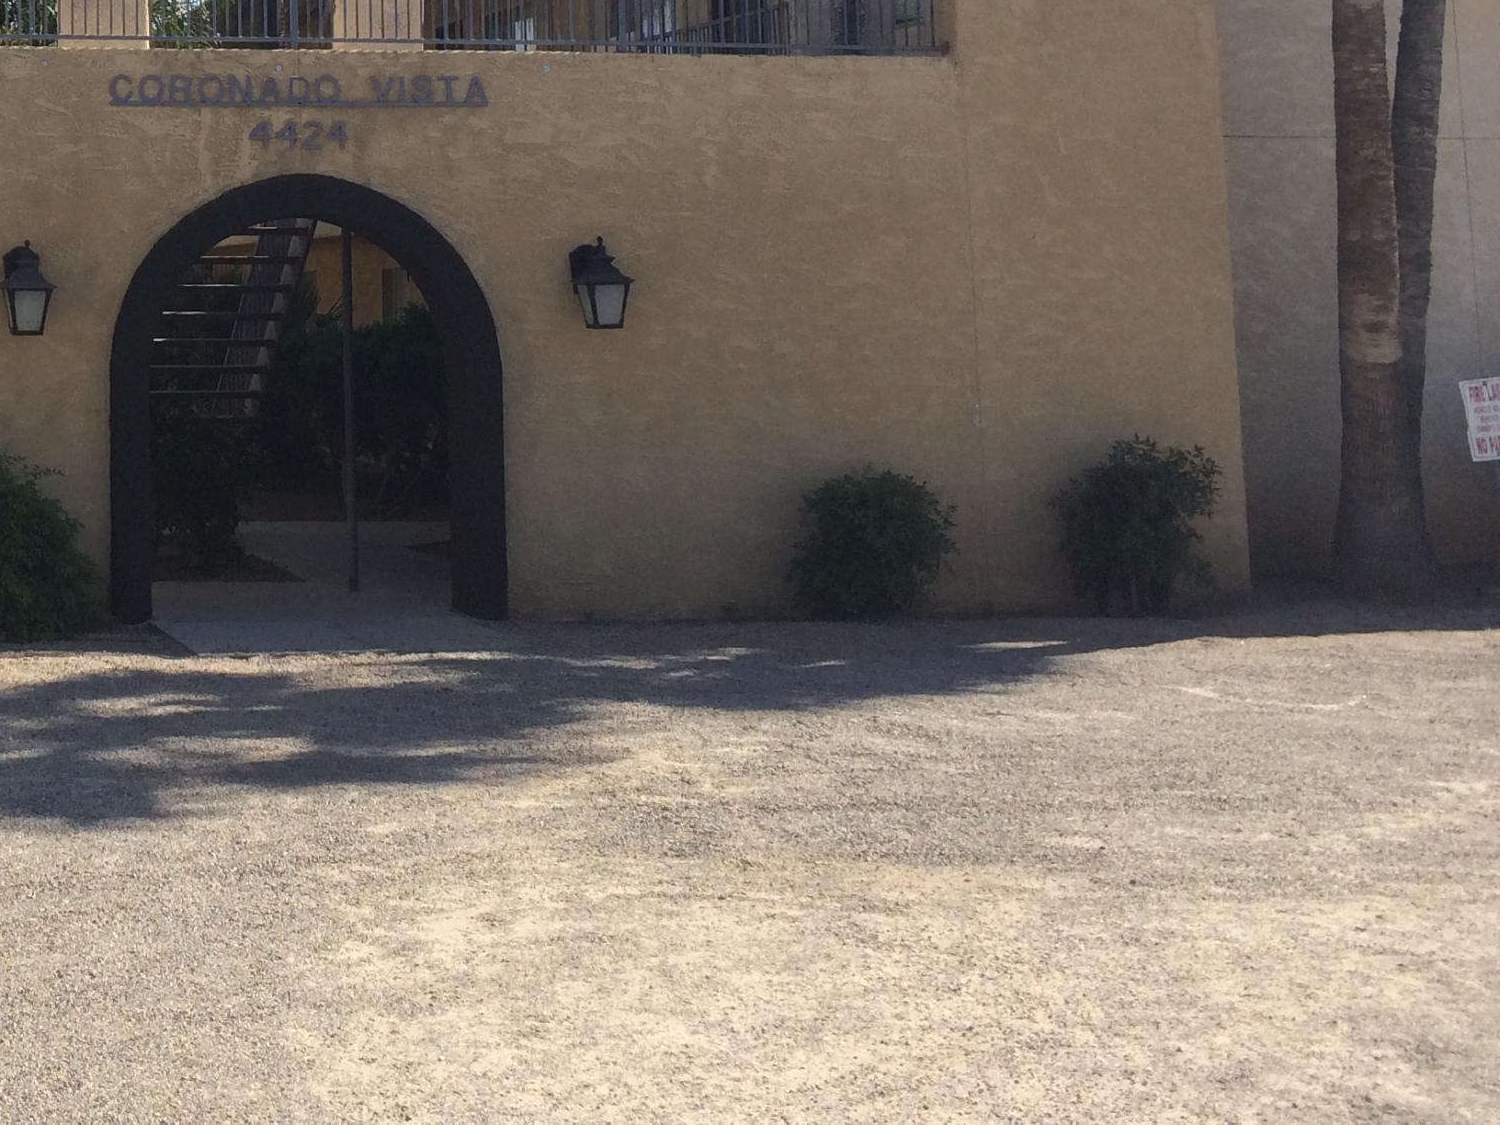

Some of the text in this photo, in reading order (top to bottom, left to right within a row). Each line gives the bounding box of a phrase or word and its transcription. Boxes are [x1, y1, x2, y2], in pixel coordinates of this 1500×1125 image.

[108, 74, 490, 106] CORONADO VISTA
[249, 121, 348, 150] 4424
